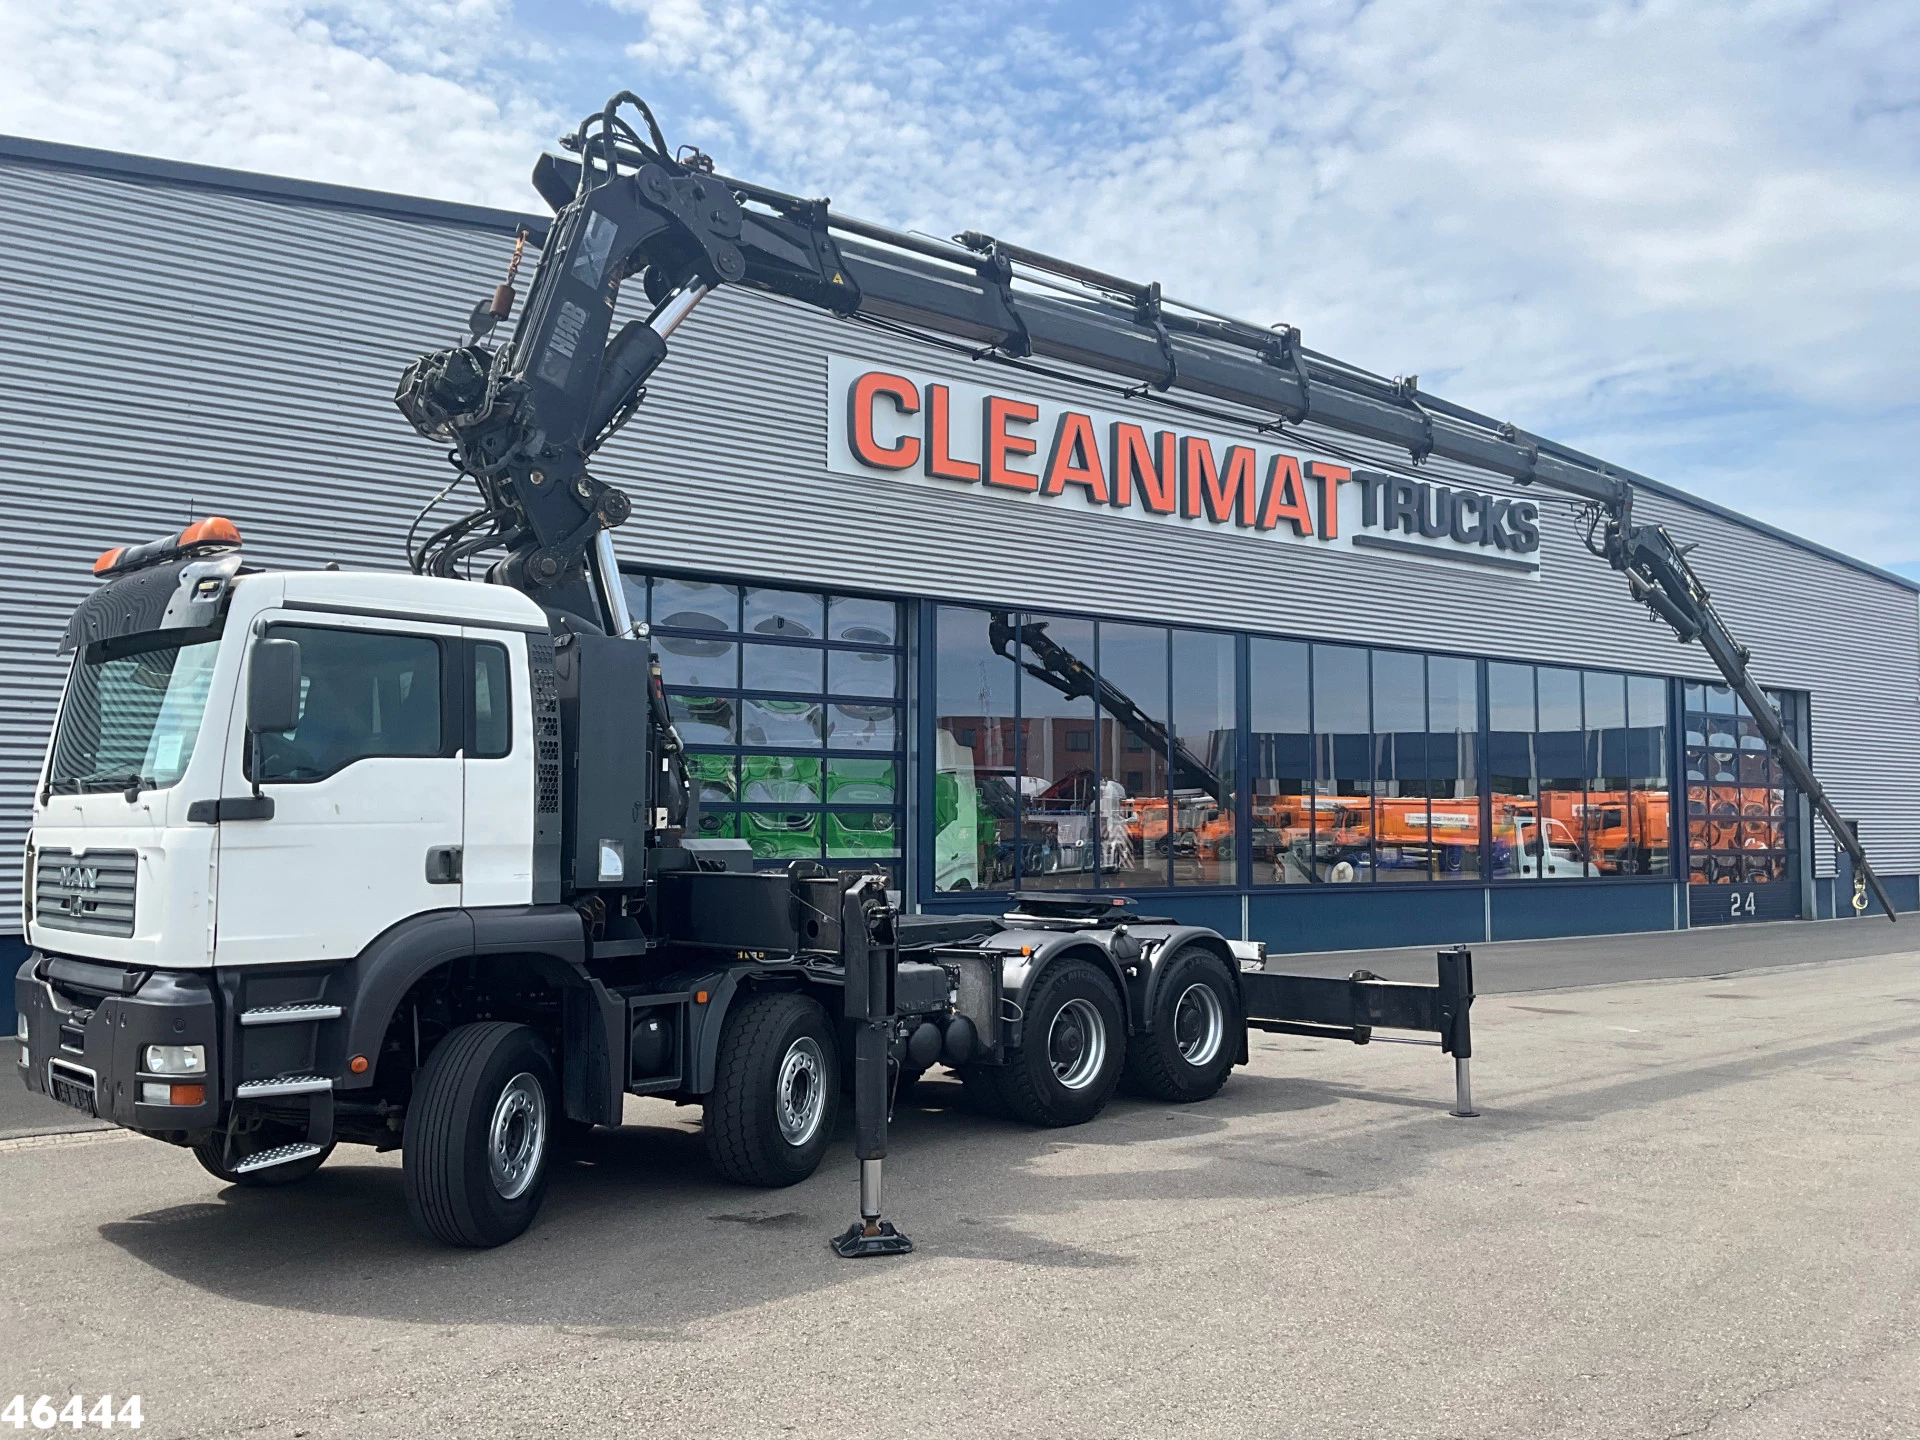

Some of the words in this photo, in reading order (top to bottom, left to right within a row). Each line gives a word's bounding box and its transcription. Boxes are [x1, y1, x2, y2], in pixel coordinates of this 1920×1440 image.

[549, 301, 587, 358] HIAB
[847, 371, 1351, 540] CLEANMAT
[1352, 470, 1540, 553] TRUCKS
[60, 866, 97, 889] MAN
[1730, 891, 1756, 917] 24
